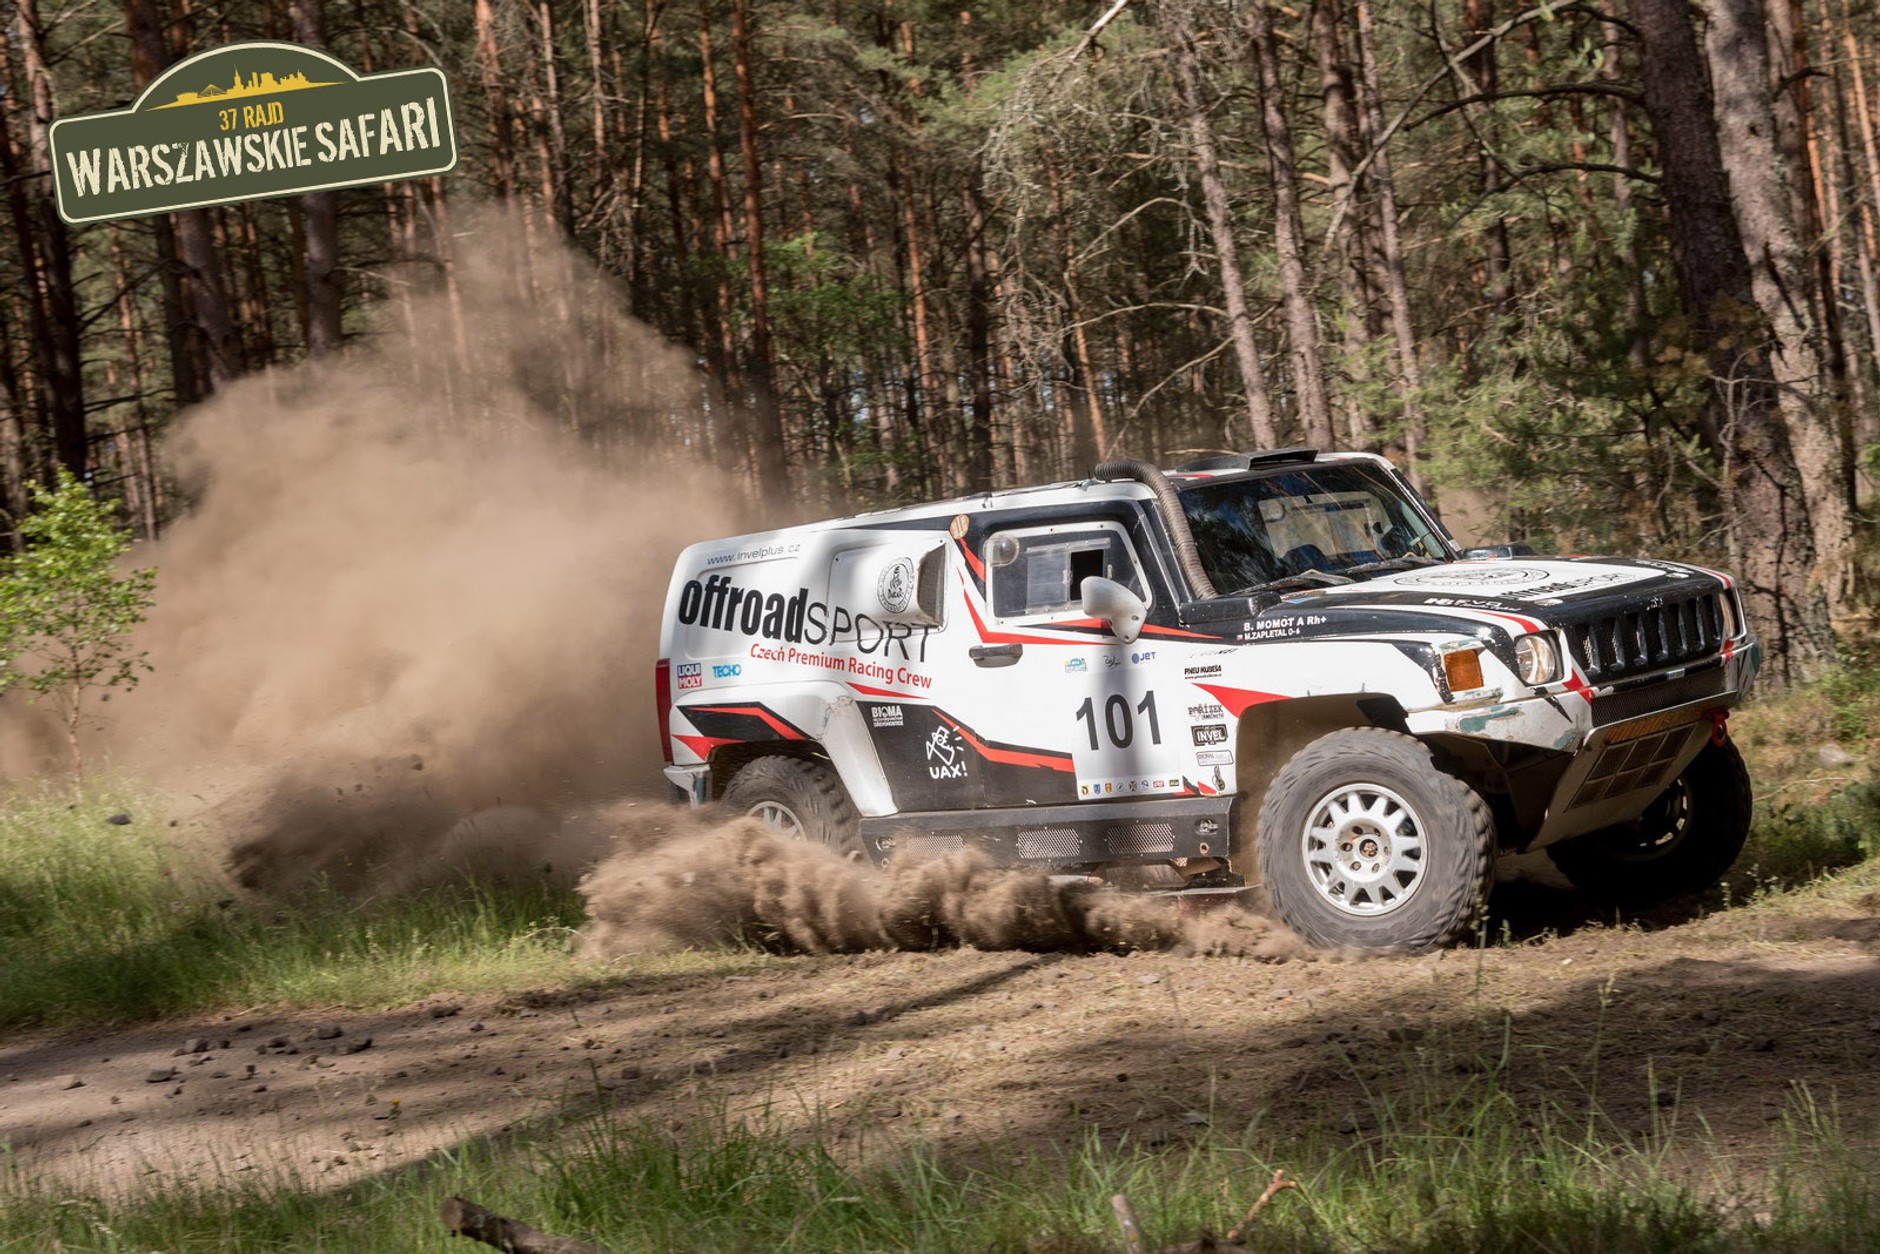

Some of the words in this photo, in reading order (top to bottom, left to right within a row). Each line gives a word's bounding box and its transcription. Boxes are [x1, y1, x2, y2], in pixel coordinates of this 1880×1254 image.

[1243, 622, 1254, 631] B.
[1256, 617, 1294, 630] MOMOT
[1296, 617, 1305, 626] A
[1306, 615, 1327, 625] Rh+
[678, 664, 701, 676] LIQUI
[750, 643, 785, 662] Czech
[788, 648, 845, 671] Premium
[848, 659, 894, 684] Racing
[897, 667, 932, 688] Crew
[678, 676, 702, 688] MOLY
[1075, 690, 1162, 751] 101
[1197, 730, 1225, 742] INVEL
[929, 761, 968, 779] UAX!
